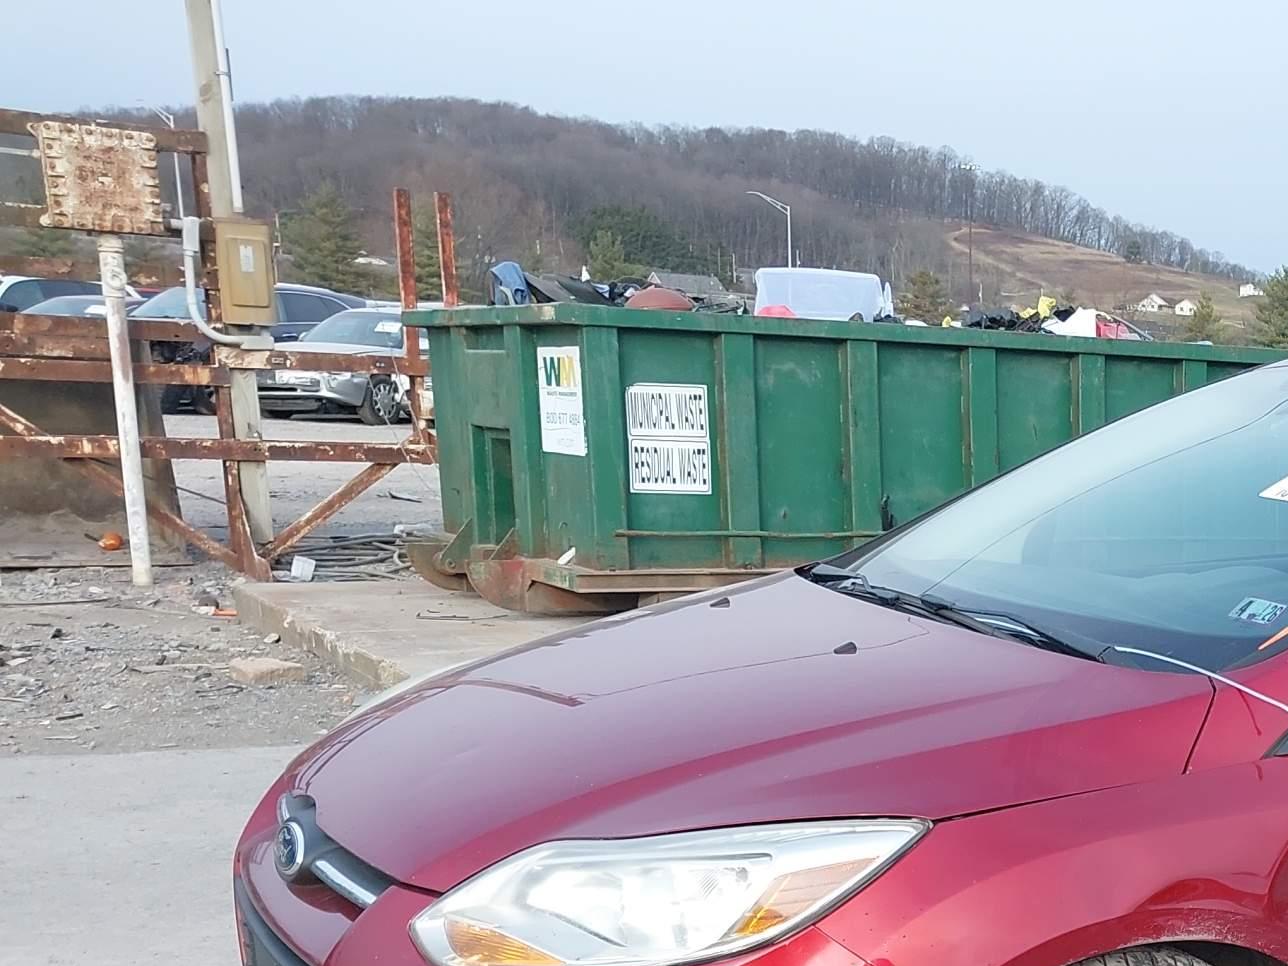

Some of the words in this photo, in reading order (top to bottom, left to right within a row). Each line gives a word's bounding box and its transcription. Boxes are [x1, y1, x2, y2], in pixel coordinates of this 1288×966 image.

[543, 356, 577, 387] WM
[630, 392, 675, 430] MUNICIPAL
[675, 393, 704, 431] WASTE
[634, 446, 677, 484] RESIDUAL
[678, 447, 707, 485] WASTE
